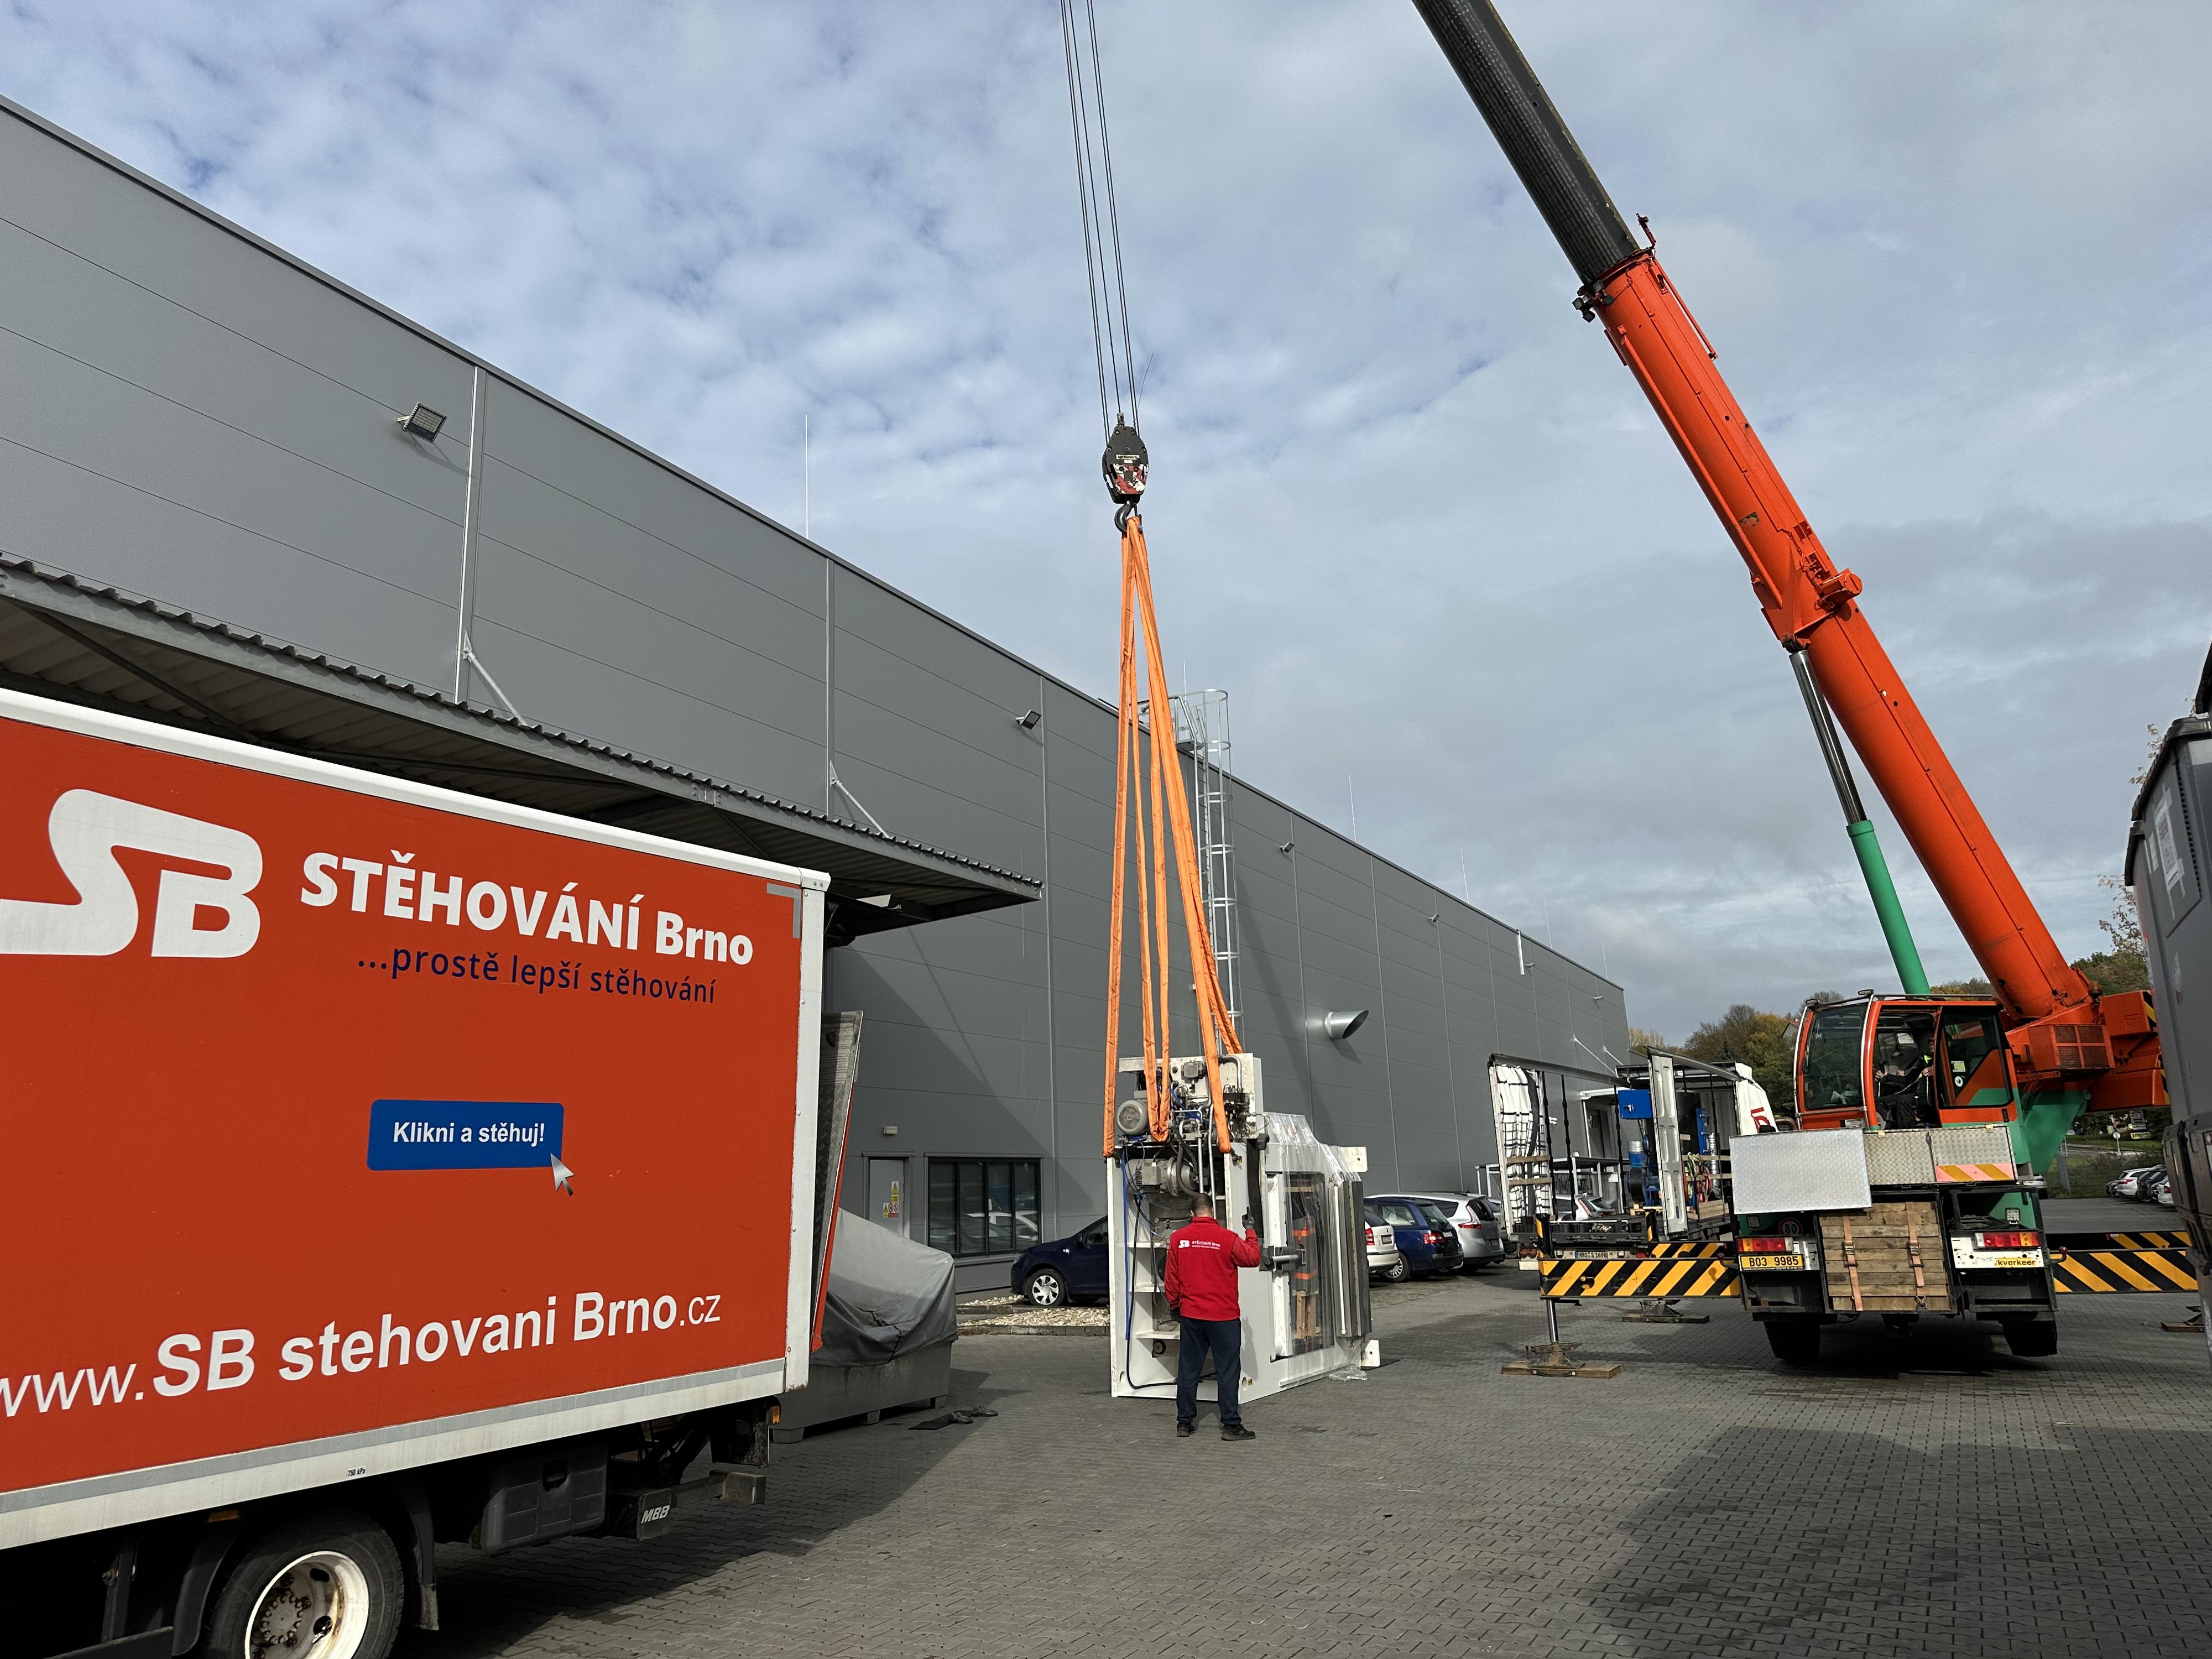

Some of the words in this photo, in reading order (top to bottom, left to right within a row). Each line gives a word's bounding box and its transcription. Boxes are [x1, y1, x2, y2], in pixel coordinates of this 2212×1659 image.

[0, 789, 263, 958] SB
[301, 849, 644, 950] STĚHOVÁNÍ
[656, 911, 753, 965] Brno
[358, 948, 499, 981] ...prostě
[512, 954, 578, 994] lepší
[590, 968, 714, 1004] stěhování
[393, 1122, 455, 1142] Klikni
[461, 1127, 472, 1142] a
[478, 1122, 545, 1147] stěhuj!
[1785, 1224, 1797, 1234] 80
[1178, 1240, 1190, 1249] SB
[1749, 1257, 1767, 1267] B03
[1774, 1256, 1799, 1266] 9985
[278, 1296, 556, 1381] stehovani
[573, 1292, 721, 1341] Brno.cz
[640, 1504, 671, 1524] MBB
